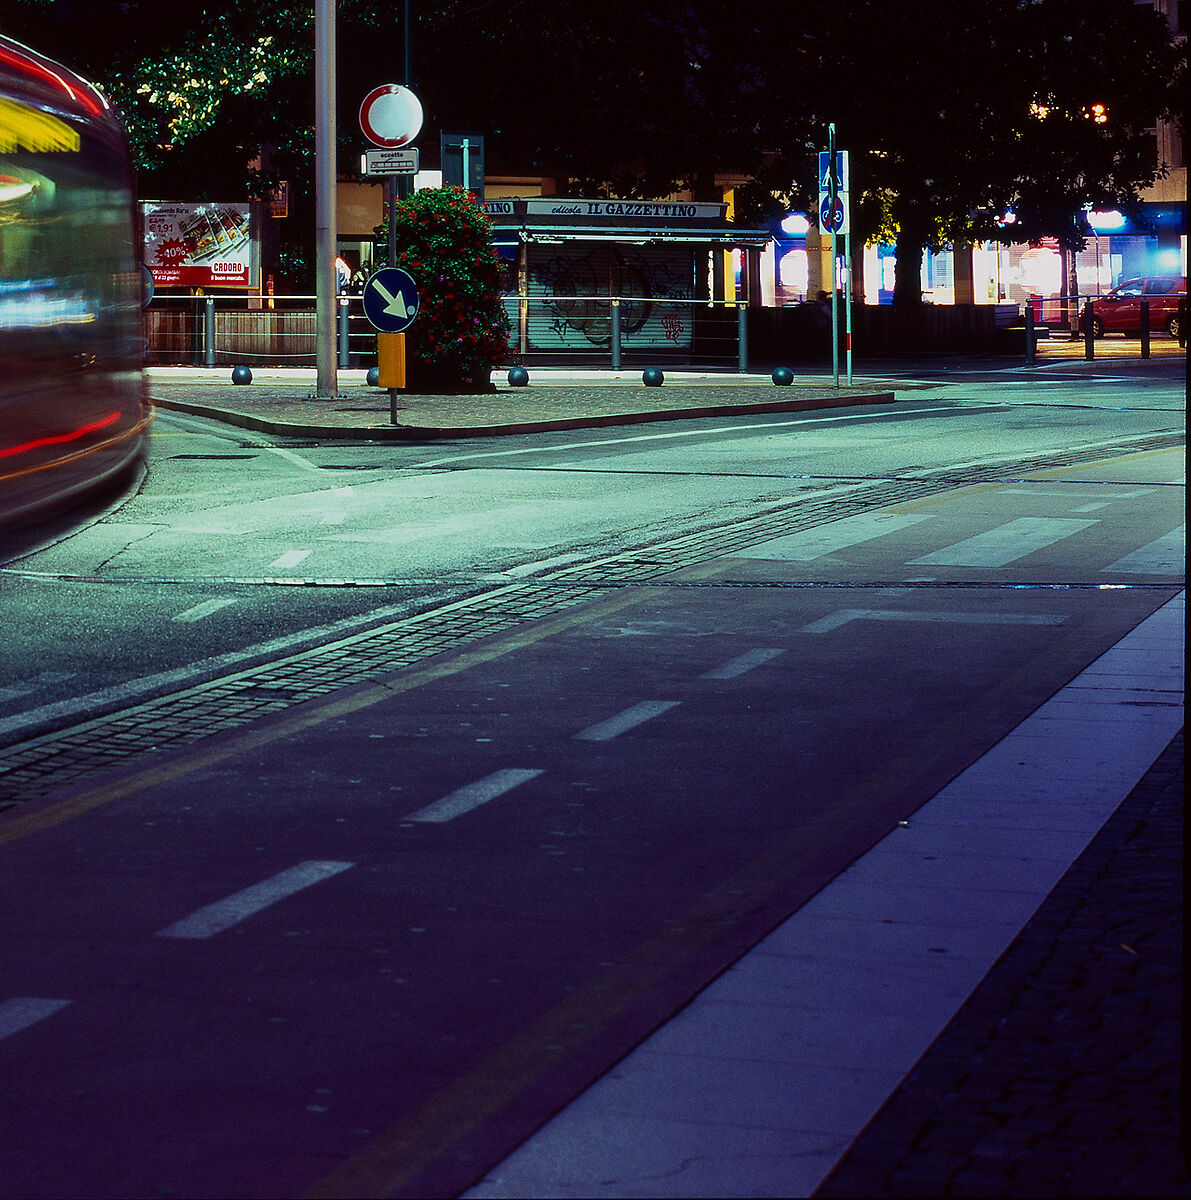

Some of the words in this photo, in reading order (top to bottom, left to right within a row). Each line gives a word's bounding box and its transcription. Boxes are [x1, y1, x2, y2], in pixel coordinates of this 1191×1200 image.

[551, 205, 582, 215] edicola
[587, 204, 603, 215] IL
[605, 204, 697, 217] GAZZETTINO
[214, 262, 242, 272] CADORO
